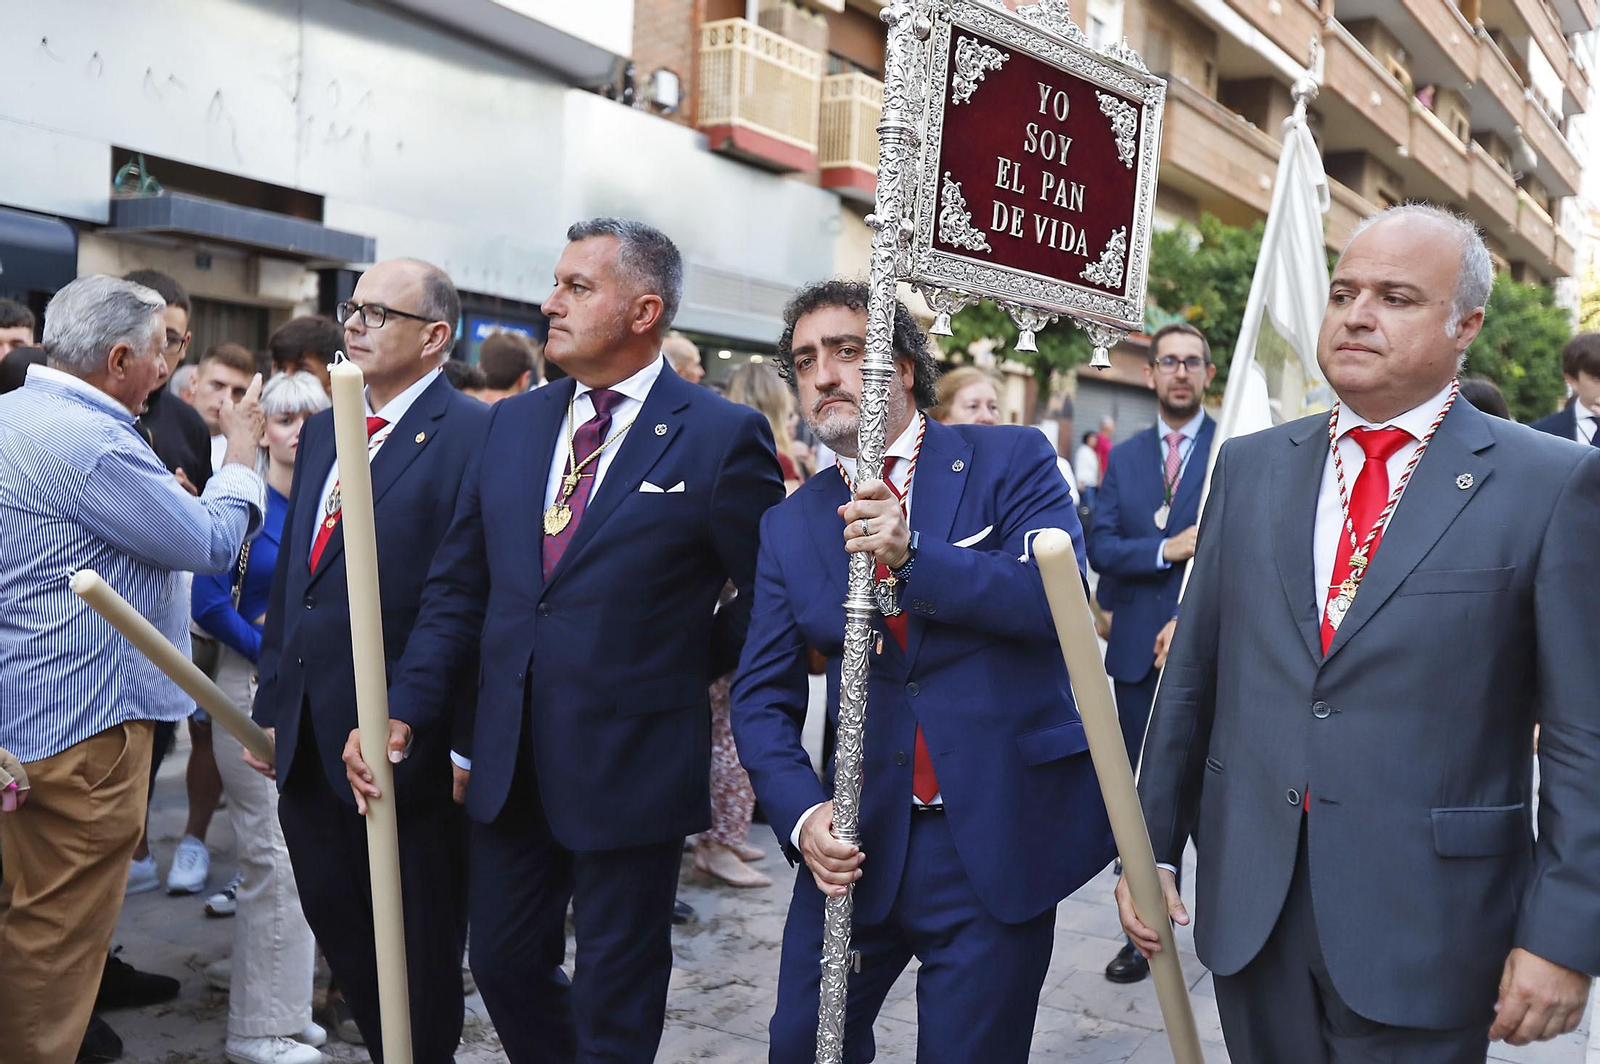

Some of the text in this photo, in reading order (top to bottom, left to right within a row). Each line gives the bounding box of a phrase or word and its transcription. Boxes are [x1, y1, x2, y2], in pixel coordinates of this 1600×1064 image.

[1037, 82, 1070, 122] YO
[1024, 122, 1073, 166] SOY
[995, 156, 1086, 213] EL PAN
[990, 200, 1089, 257] DE VIDA
